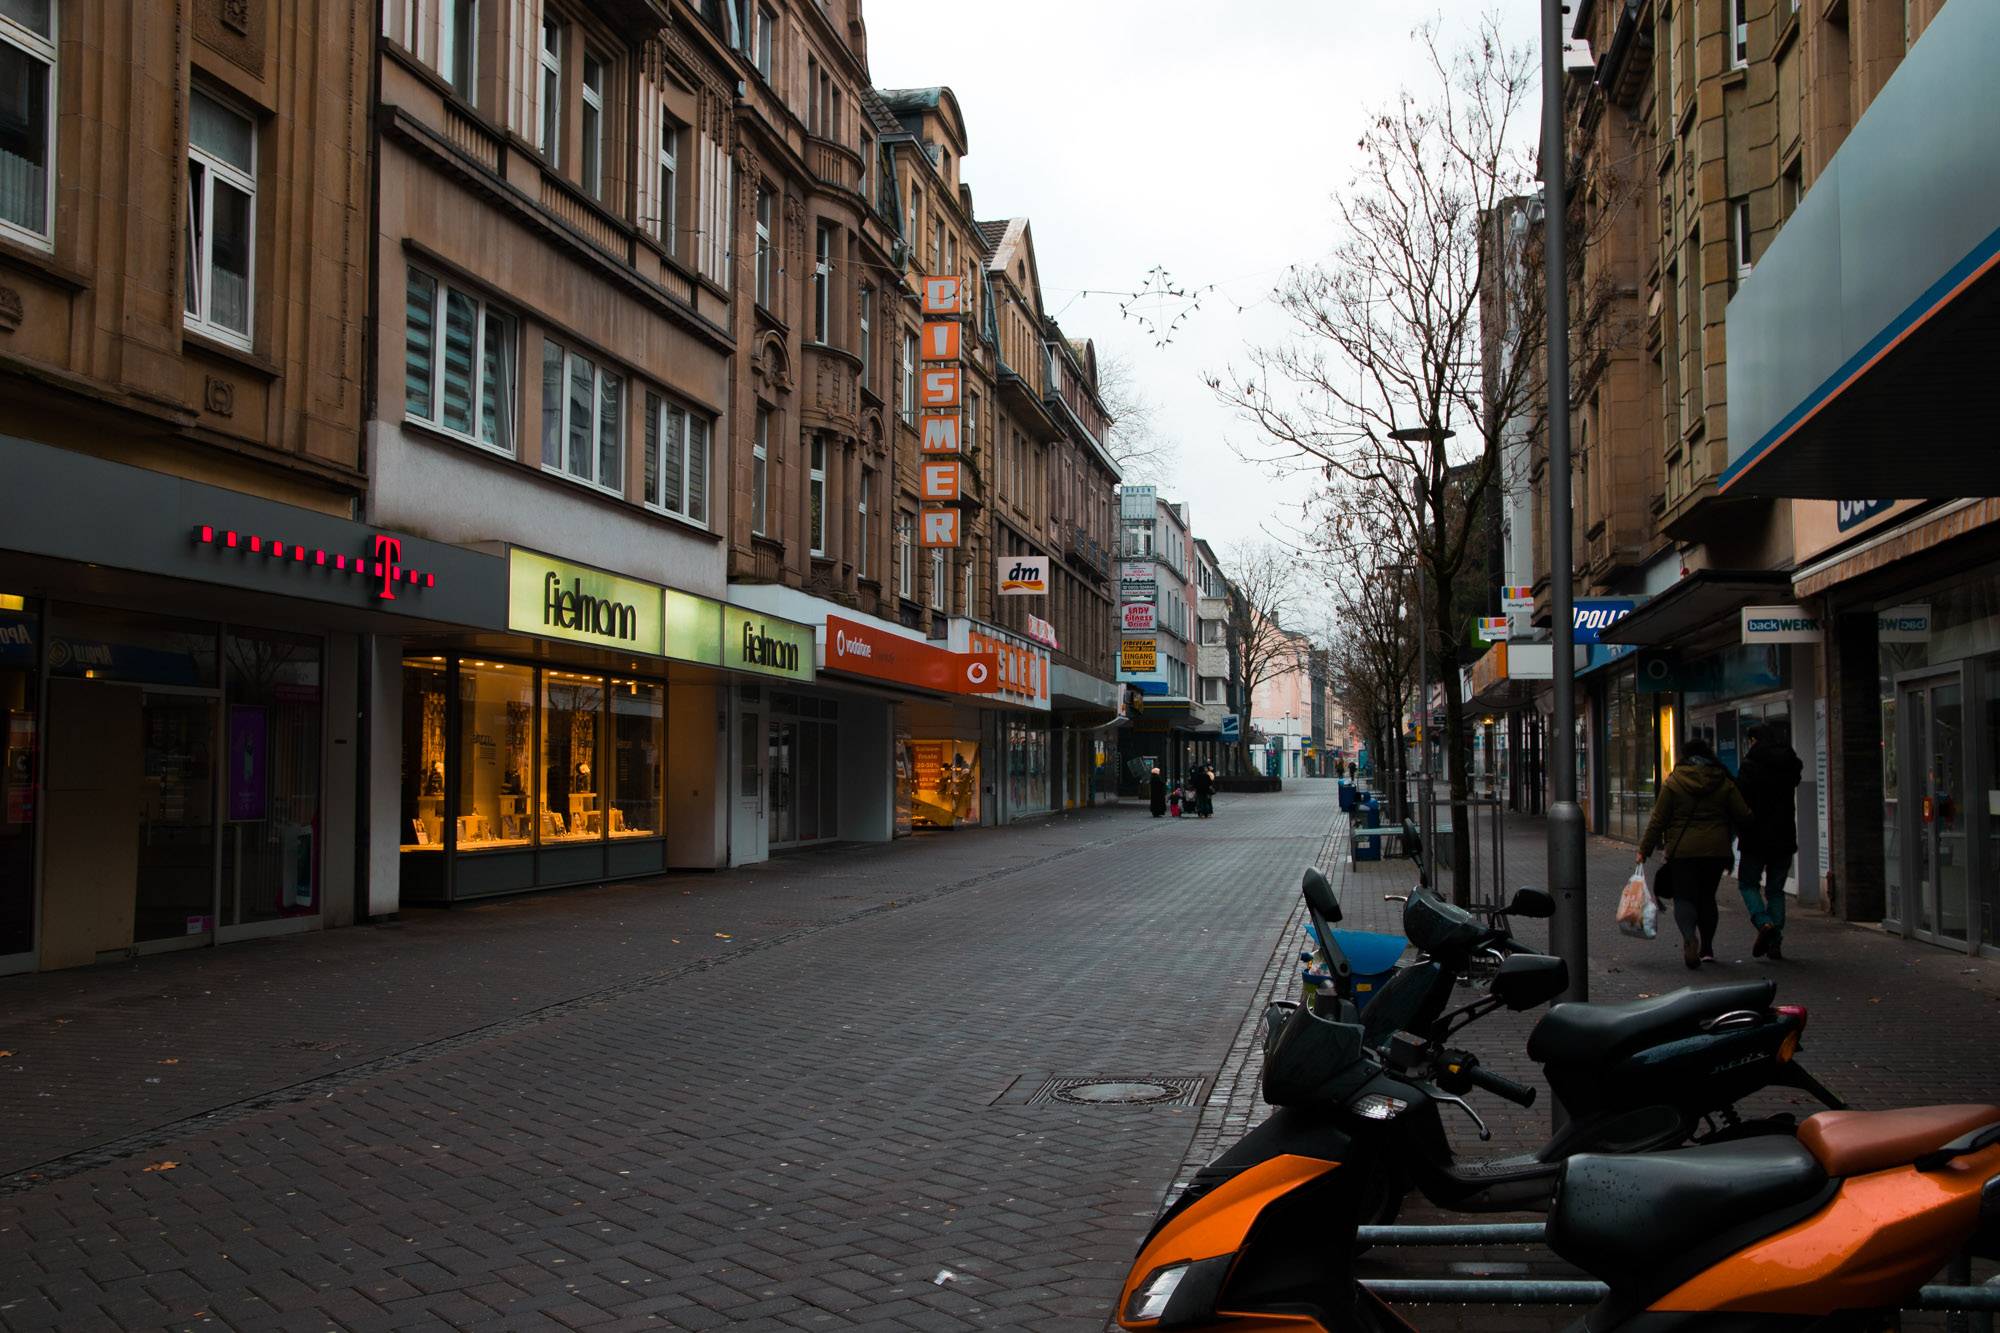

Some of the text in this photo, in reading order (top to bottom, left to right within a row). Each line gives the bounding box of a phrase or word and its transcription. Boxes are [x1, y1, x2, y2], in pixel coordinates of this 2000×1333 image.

[924, 280, 957, 543] DISMER
[1008, 563, 1040, 581] dm
[544, 571, 637, 641] fielmann
[742, 621, 799, 672] fielmann
[846, 635, 872, 659] vodafone
[974, 640, 1036, 690] SMER
